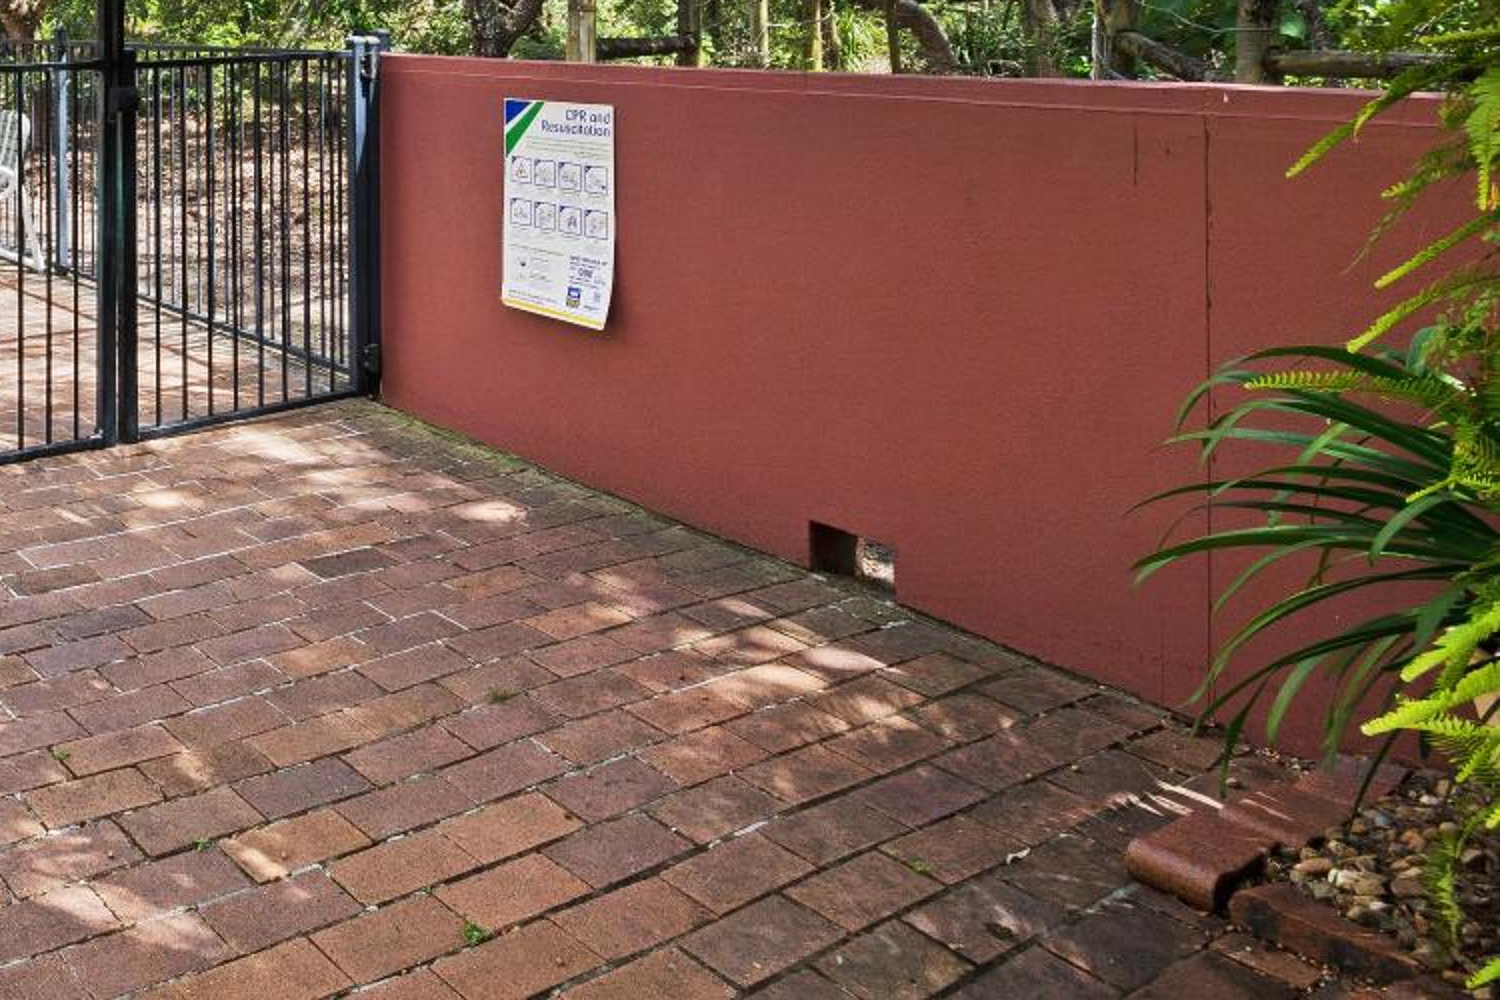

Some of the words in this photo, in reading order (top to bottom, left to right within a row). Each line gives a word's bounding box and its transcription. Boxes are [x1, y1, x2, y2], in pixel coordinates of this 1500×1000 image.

[565, 109, 587, 122] CPR
[589, 112, 611, 125] and
[541, 119, 611, 137] Resuscitation
